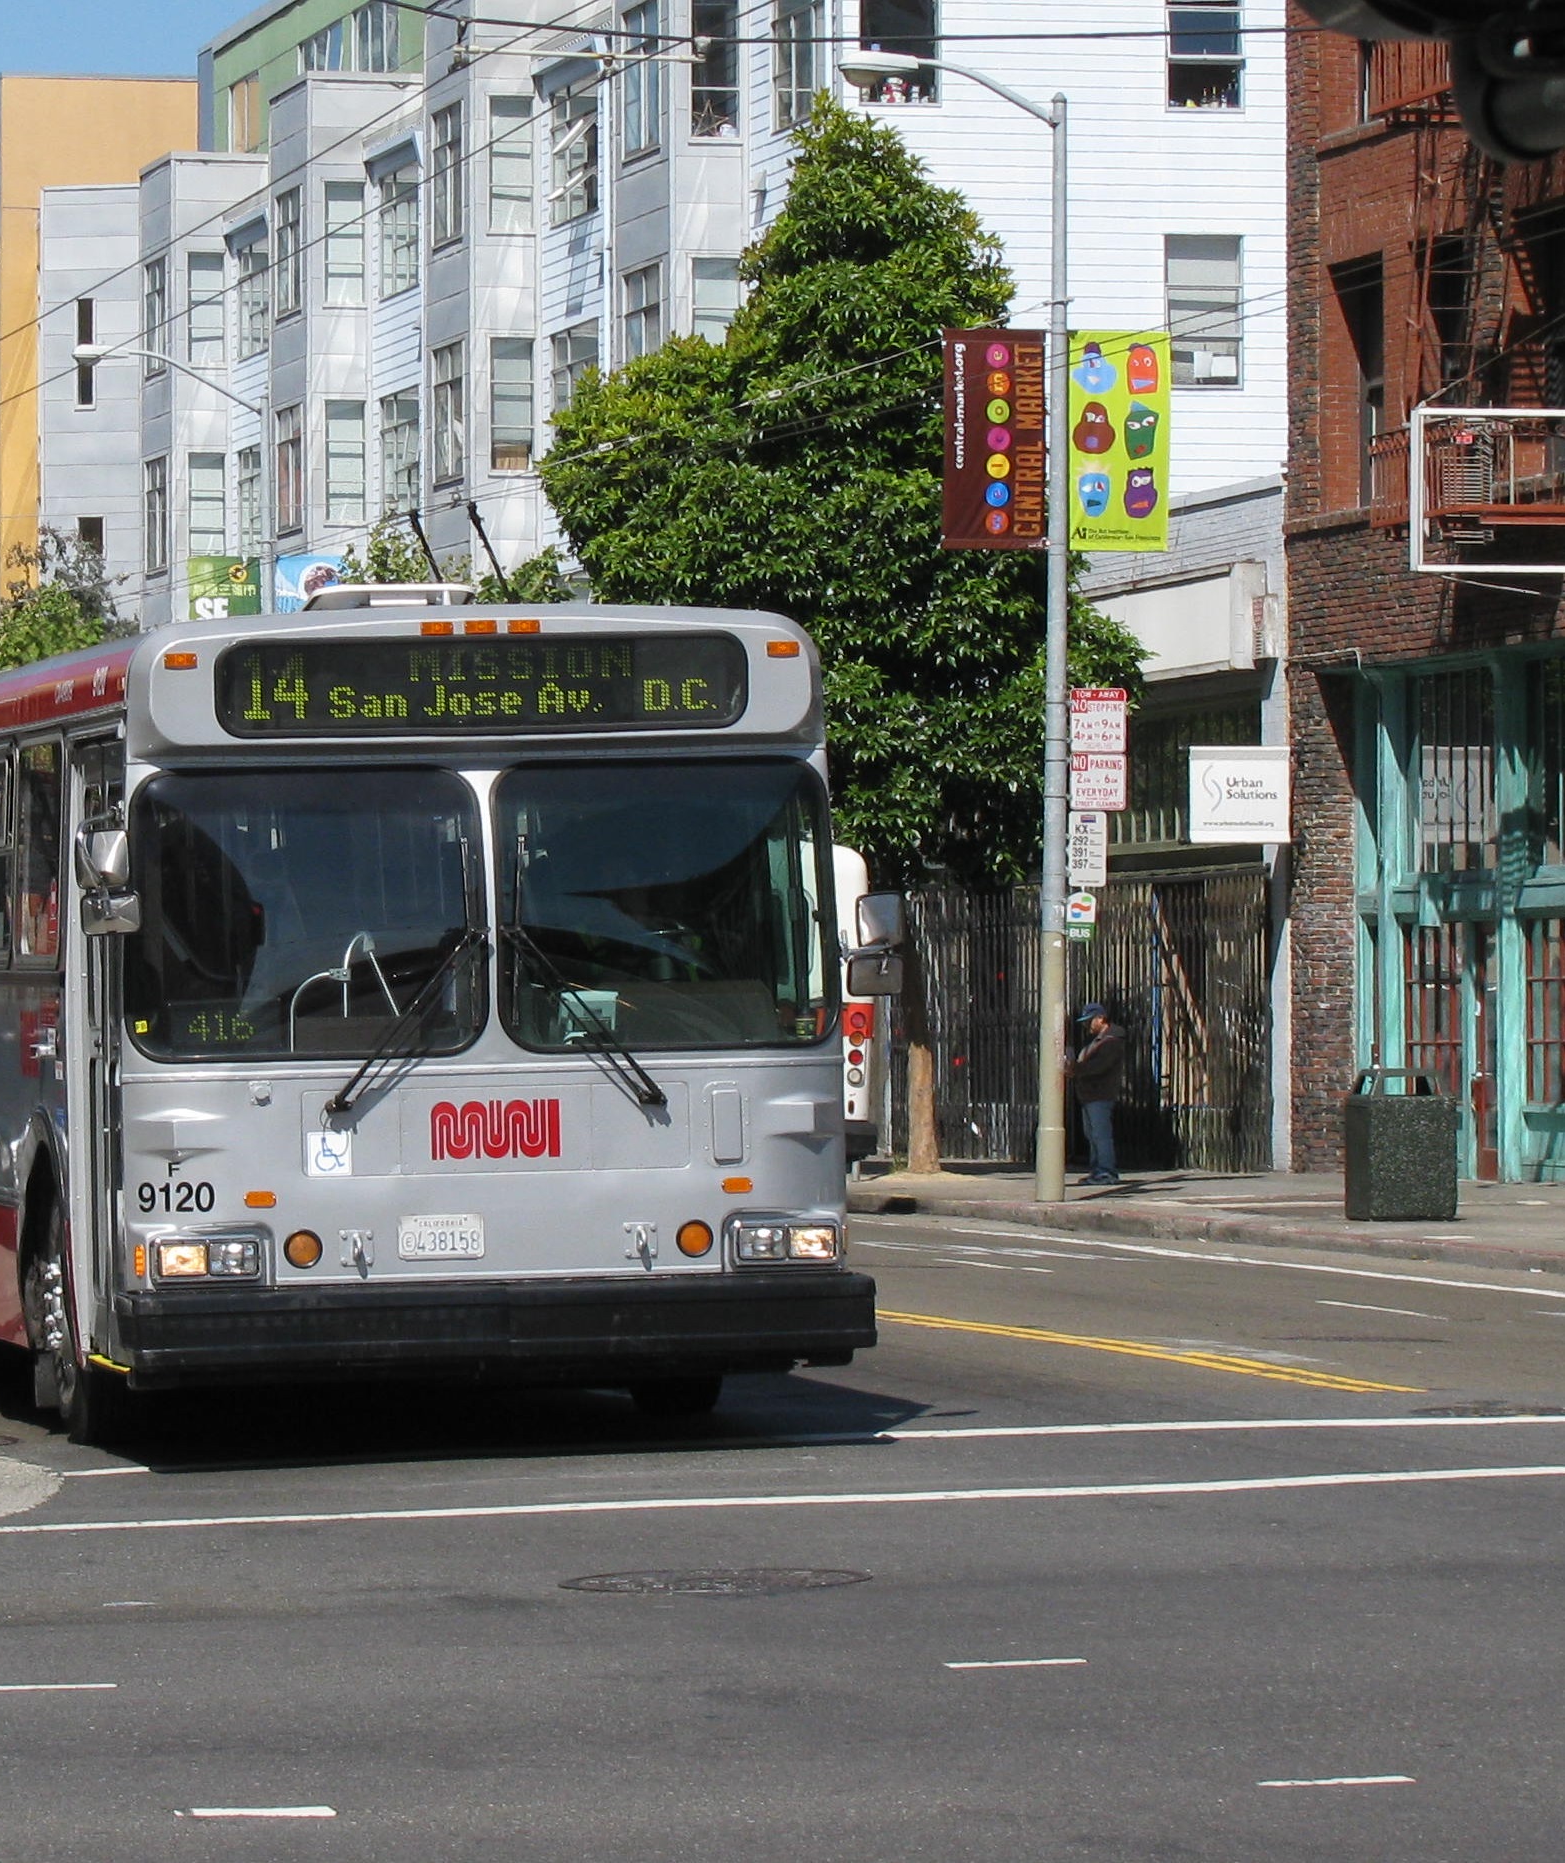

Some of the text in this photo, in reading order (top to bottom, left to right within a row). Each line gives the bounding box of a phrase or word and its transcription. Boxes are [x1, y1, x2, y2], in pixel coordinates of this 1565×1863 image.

[1013, 344, 1043, 430] MARKET
[954, 342, 967, 470] central-market.org
[1013, 440, 1043, 537] CENTRAL
[407, 643, 635, 683] MISSION
[242, 677, 720, 720] 14 San Jose Av. D.C.
[1072, 700, 1087, 712] NO
[1072, 756, 1123, 770] NO PARKING
[1226, 776, 1264, 788] Urban
[1076, 787, 1118, 797] EVERYDAY
[1226, 789, 1279, 800] Solutions
[1075, 824, 1088, 834] KX
[1072, 835, 1089, 846] 292
[1072, 847, 1089, 858] 391
[1072, 859, 1089, 869] 397
[1069, 928, 1091, 938] BUS
[188, 1010, 255, 1041] 416
[167, 1161, 181, 1177] F
[137, 1181, 216, 1213] 9120
